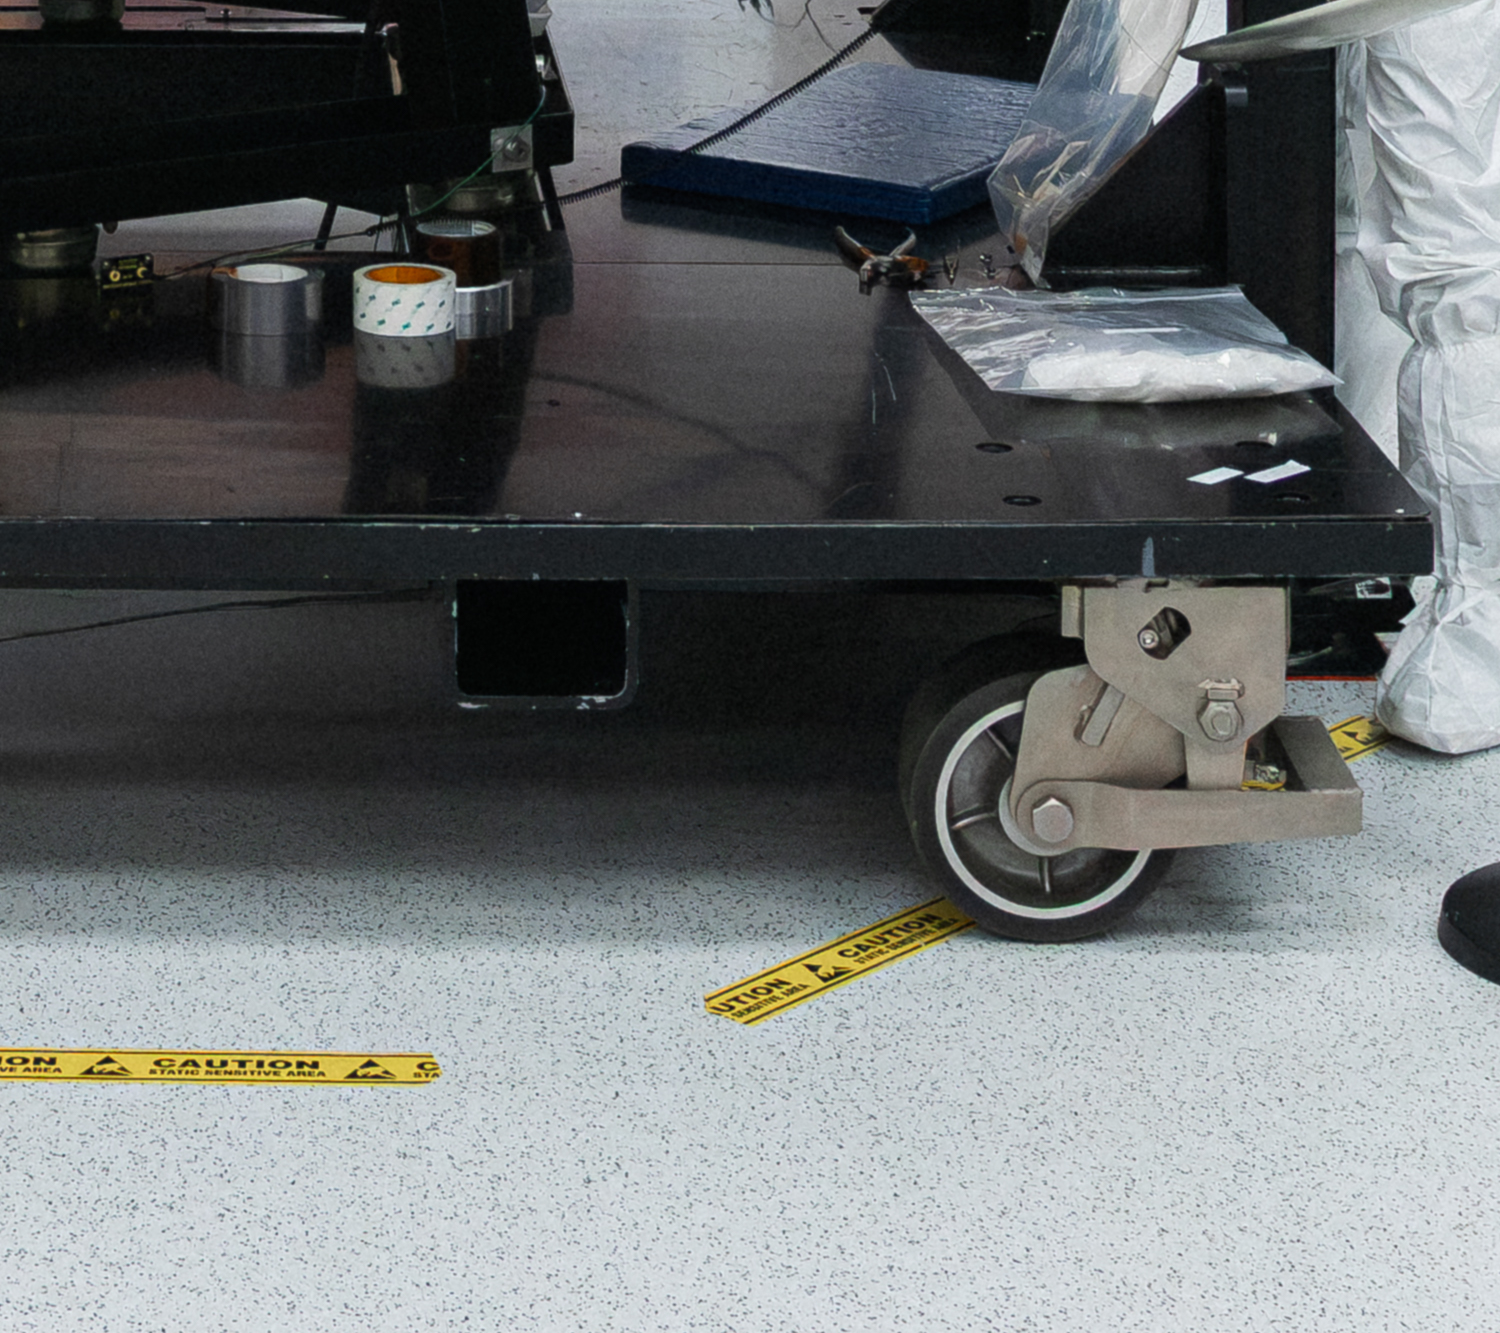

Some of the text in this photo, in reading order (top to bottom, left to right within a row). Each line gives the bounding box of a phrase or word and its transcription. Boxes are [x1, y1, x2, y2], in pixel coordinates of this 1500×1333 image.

[838, 913, 943, 958] CAUTION
[153, 1058, 320, 1070] CAUTION
[22, 1066, 62, 1074] AREA
[149, 1068, 326, 1078] STATIC SENSITIVE AREA
